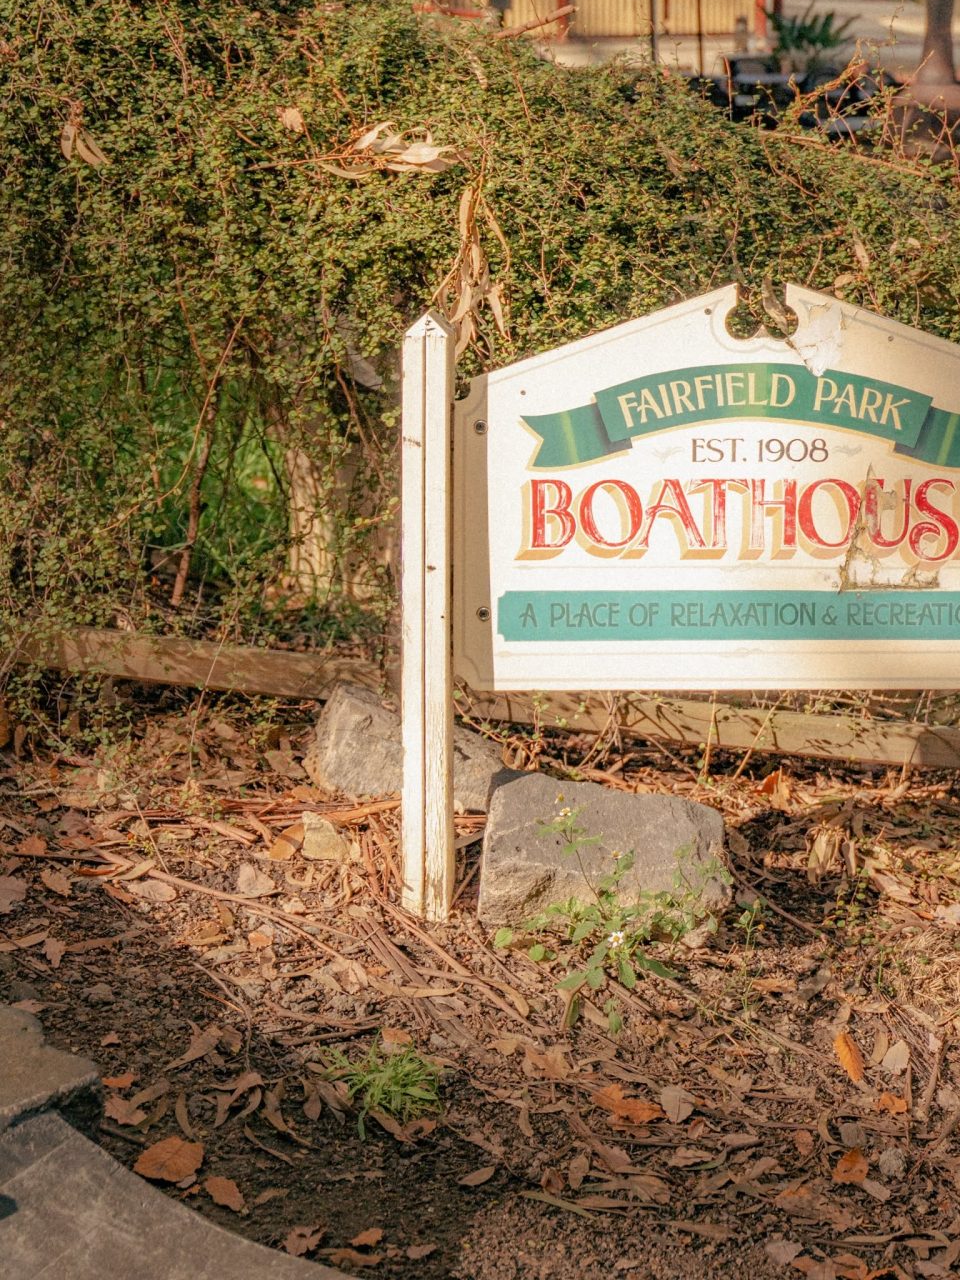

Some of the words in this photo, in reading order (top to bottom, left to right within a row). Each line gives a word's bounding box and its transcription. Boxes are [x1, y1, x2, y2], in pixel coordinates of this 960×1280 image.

[617, 372, 796, 428] FAIRFIELD
[812, 375, 911, 430] PARK
[691, 437, 747, 463] EST.
[757, 437, 830, 464] 1908
[519, 602, 538, 628] A
[550, 602, 620, 628] PLACE
[628, 602, 659, 627] OF
[670, 602, 816, 627] RELAXATION
[821, 604, 838, 627] &
